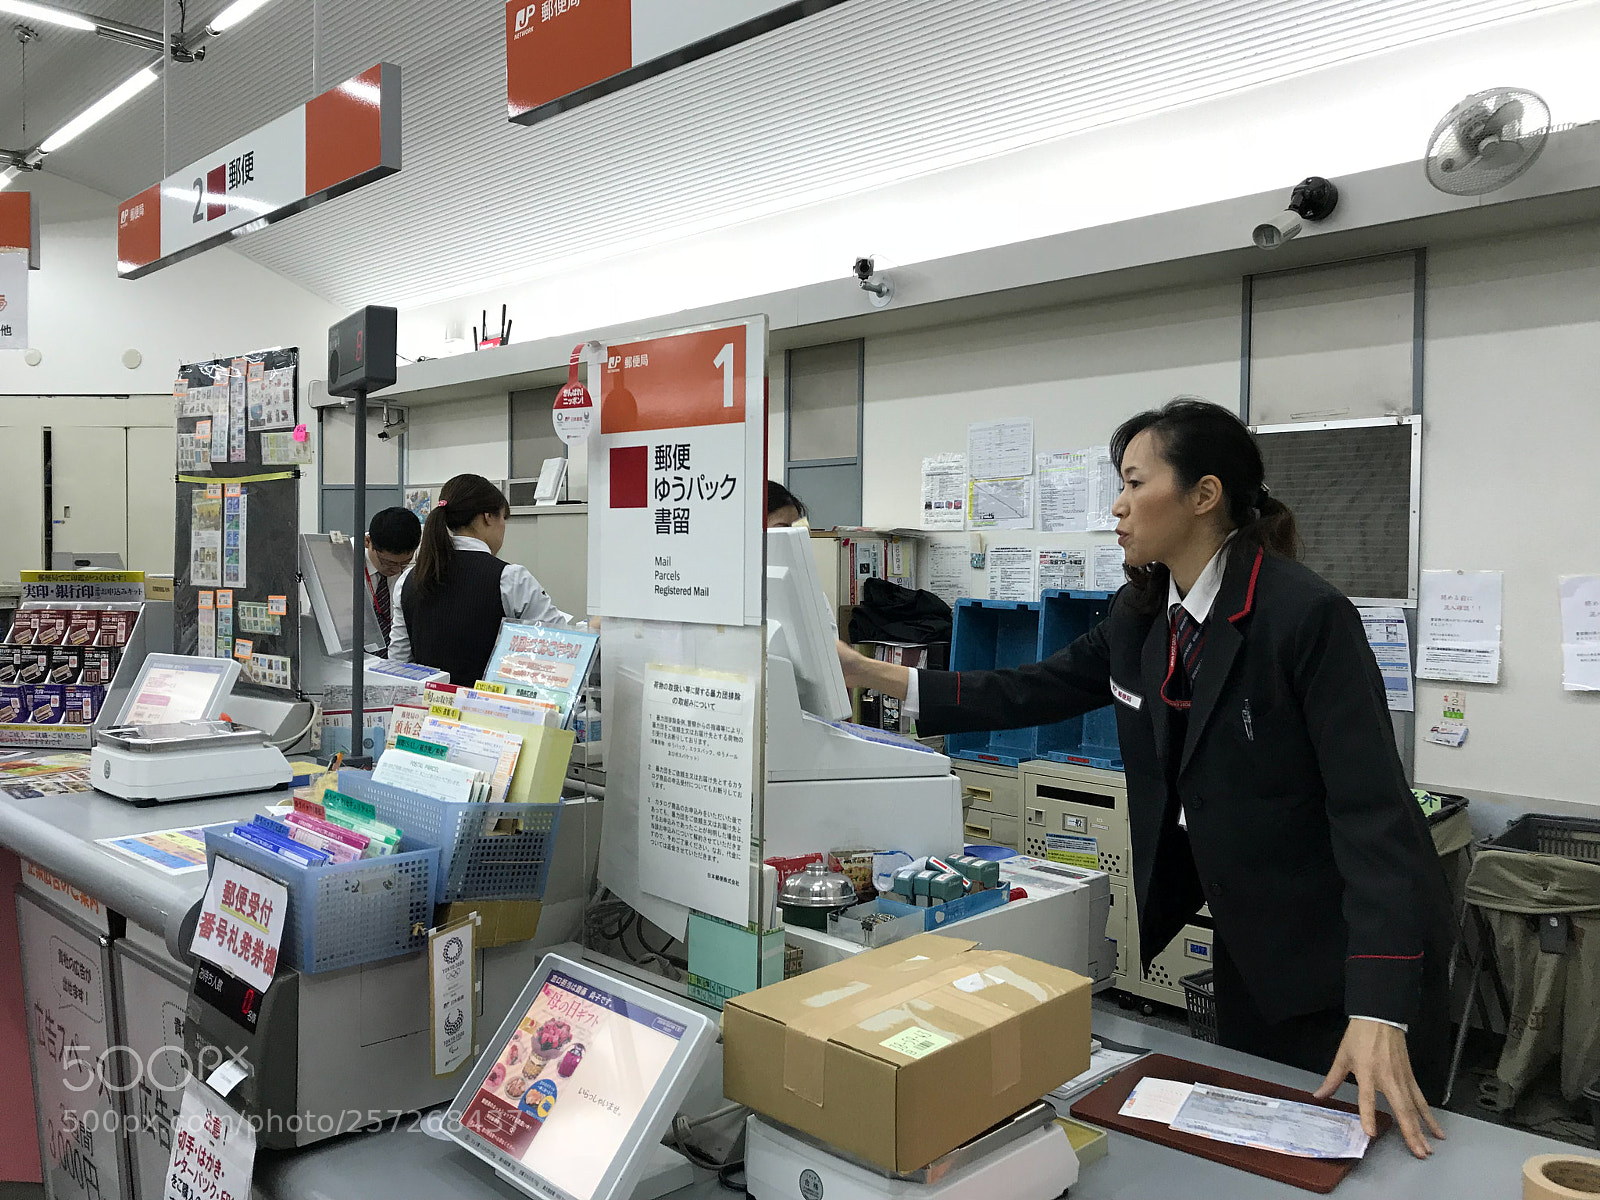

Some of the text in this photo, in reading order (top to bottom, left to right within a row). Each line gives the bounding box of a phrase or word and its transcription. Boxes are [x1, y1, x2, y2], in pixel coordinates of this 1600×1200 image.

[192, 150, 255, 224] 2 郵便
[624, 353, 649, 369] 郵便局
[713, 342, 734, 408] 1
[654, 443, 691, 472] 郵便
[654, 474, 737, 502] ゆうパック
[654, 507, 690, 535] 書留
[654, 556, 672, 567] Mail
[654, 570, 681, 581] Parcels
[654, 585, 709, 597] Registered Mail
[671, 697, 716, 711] の取組みについて
[221, 879, 273, 929] 郵便受付
[198, 911, 278, 977] 番号札発券機
[547, 991, 599, 1027] 母の日ギフト
[139, 1074, 181, 1155] 広告
[203, 1107, 229, 1146] 注意!
